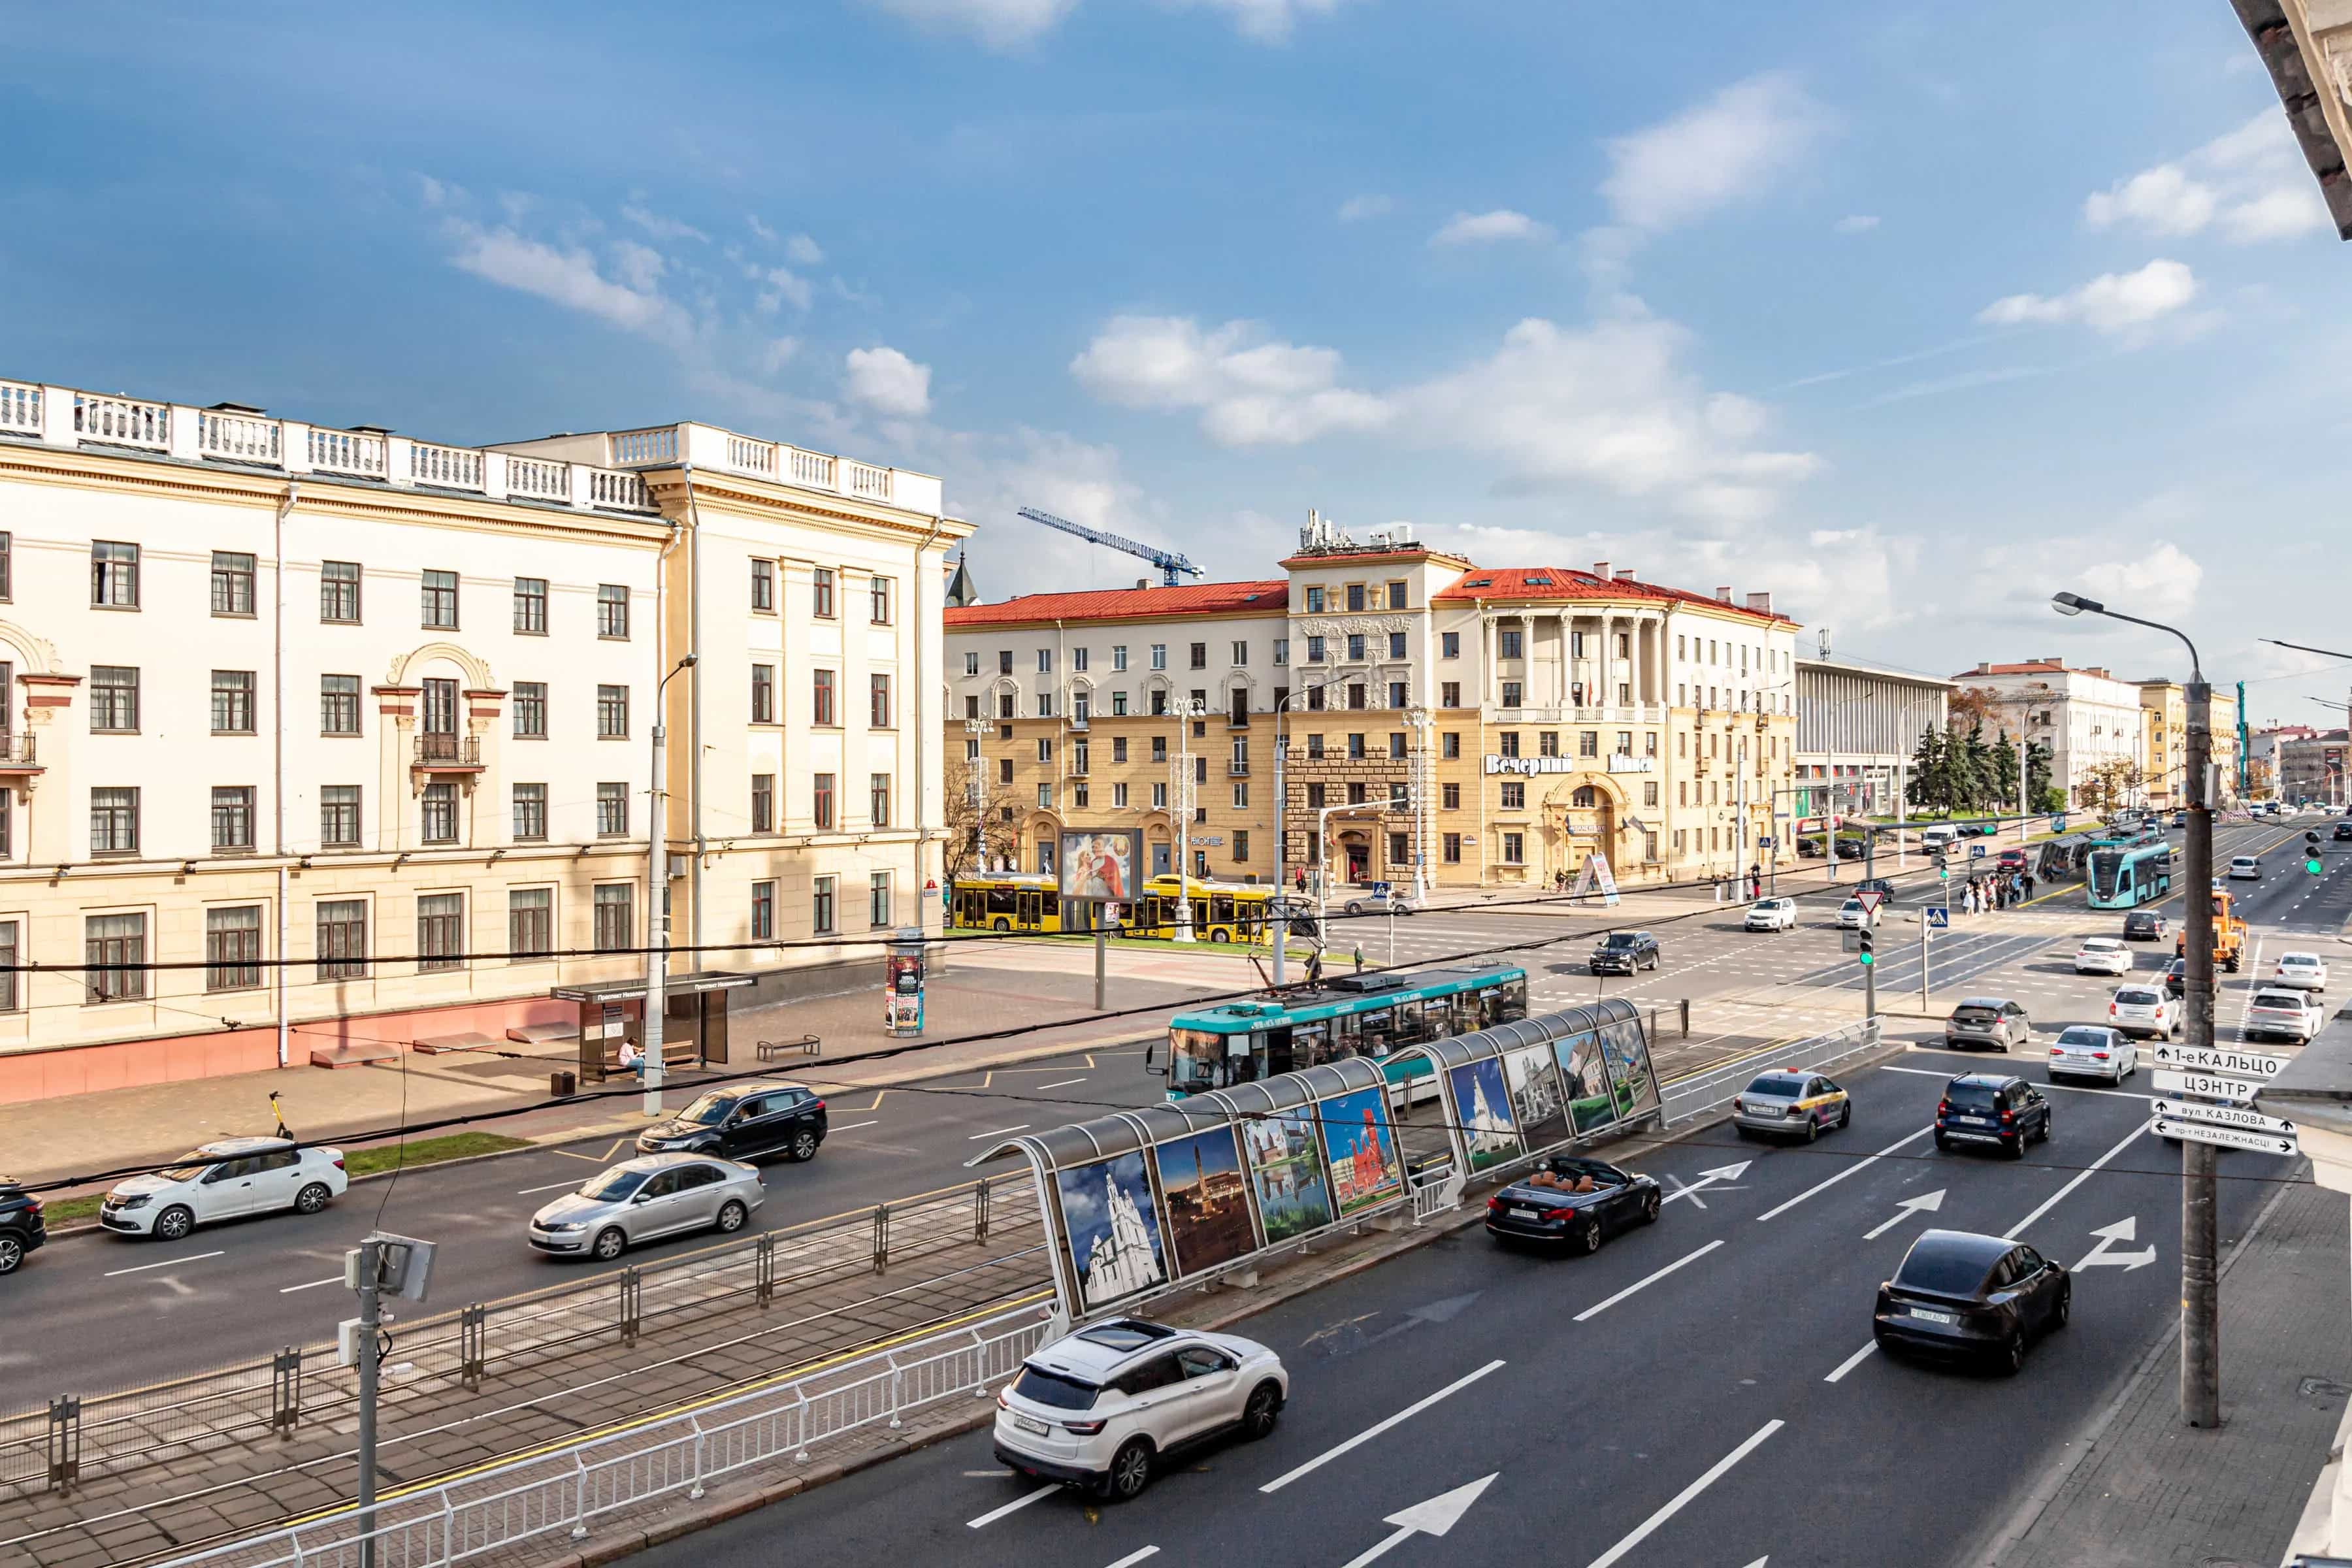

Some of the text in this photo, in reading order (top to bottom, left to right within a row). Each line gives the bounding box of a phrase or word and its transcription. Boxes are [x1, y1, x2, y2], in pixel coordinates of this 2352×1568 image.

[1484, 753, 1573, 778] Вечерний
[2174, 1049, 2277, 1075] 1-е КАЛЬЦО
[2184, 1076, 2248, 1096] ЦЭНТР
[2206, 1109, 2266, 1126] КАЗЛОВА
[2193, 1128, 2270, 1148] НЕЗАЛЕЖНАСЦІ
